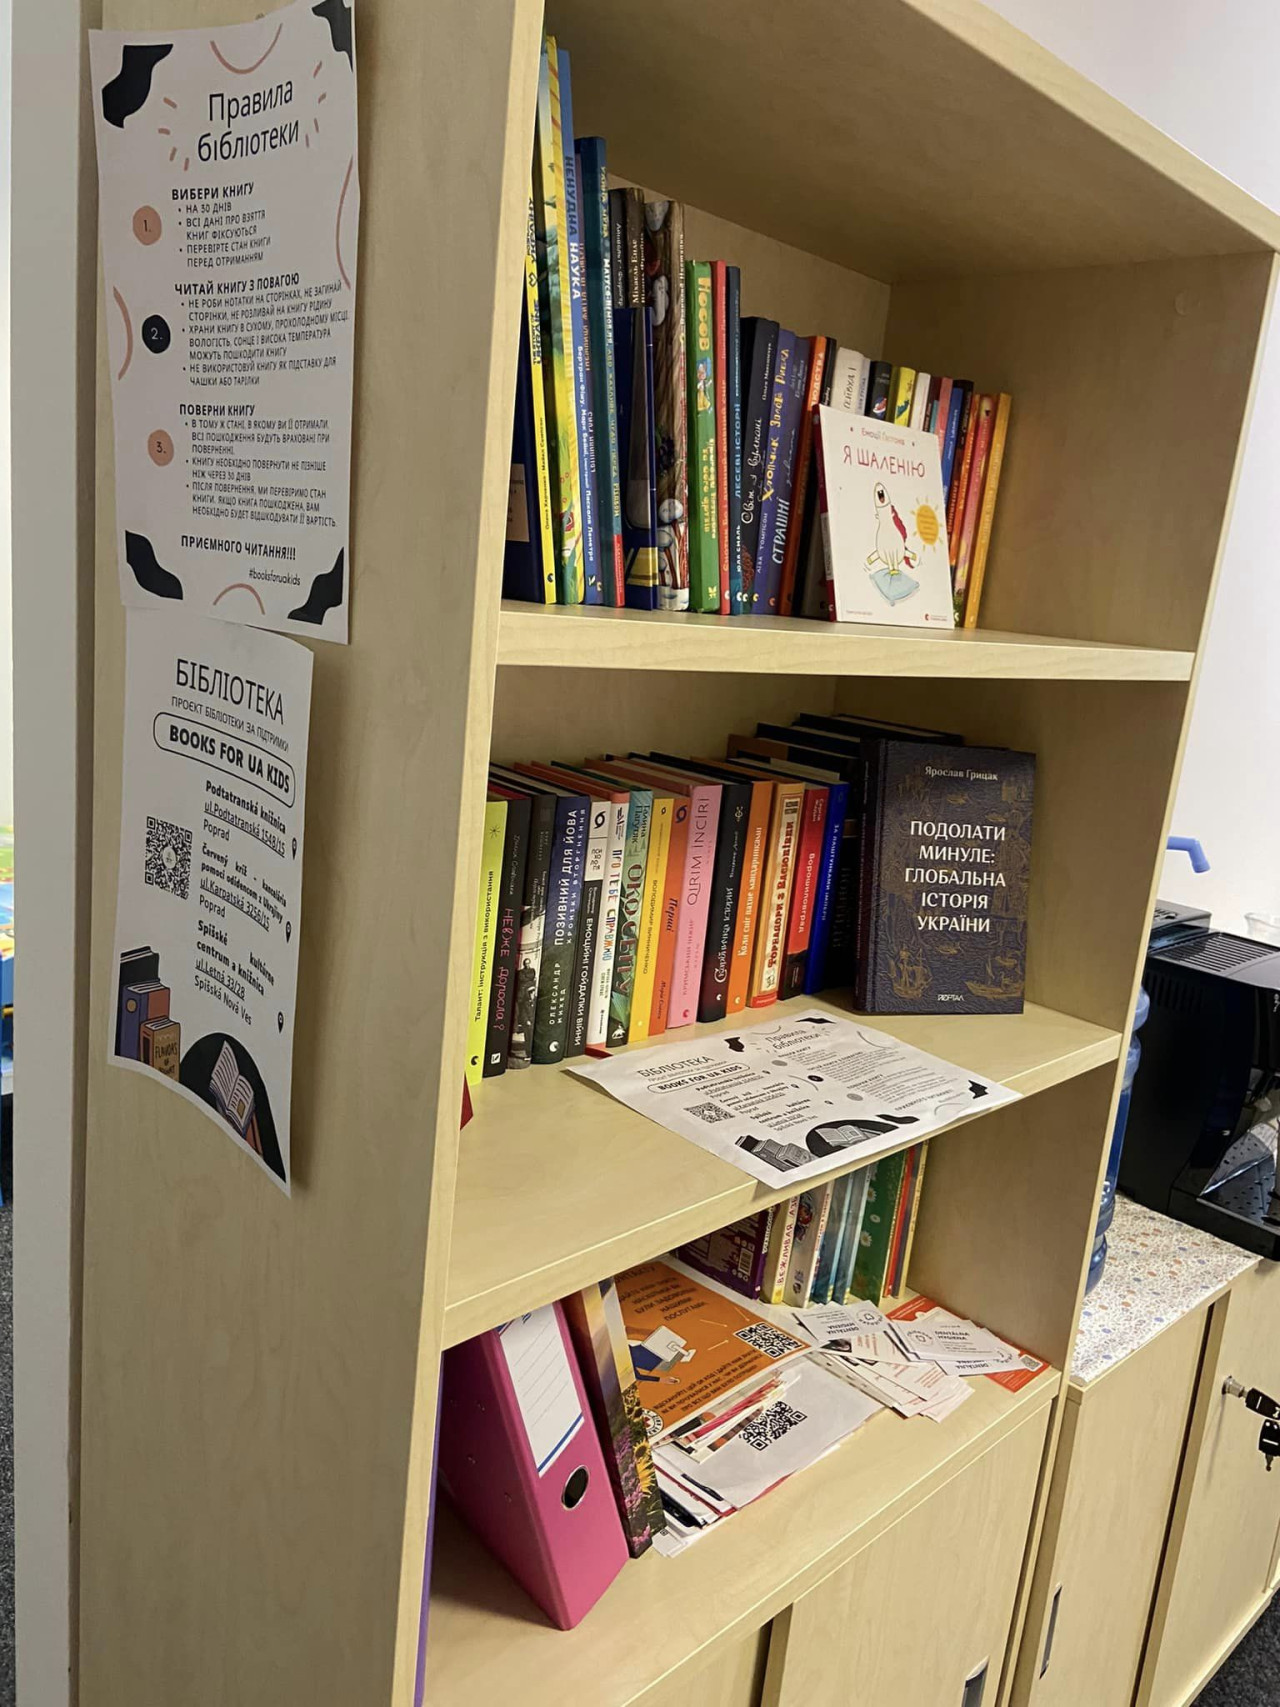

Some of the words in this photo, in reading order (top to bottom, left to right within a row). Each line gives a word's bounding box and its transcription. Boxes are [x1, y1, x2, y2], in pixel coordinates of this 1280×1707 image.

[208, 80, 293, 128] Правила
[197, 119, 299, 161] бібліотеки
[172, 187, 219, 200] ВИБЕРИ
[222, 182, 254, 198] КНИГУ
[564, 156, 578, 236] НЕНУДНА
[186, 204, 198, 214] НА
[212, 202, 232, 214] ДНІВ
[186, 218, 200, 227] ВСІ
[204, 216, 222, 228] ДАНІ
[226, 214, 240, 224] ПРО
[242, 210, 266, 222] ВЗЯТТЯ
[187, 231, 208, 240] КНИГ
[212, 225, 257, 239] ФІКСУЮТЬСЯ
[187, 243, 228, 254] ПЕРЕВІРТЕ
[231, 241, 248, 251] СТАН
[250, 236, 270, 248] КНИГИ
[188, 257, 214, 268] ПЕРЕД
[216, 252, 264, 266] ОТРИМАННЯМ
[569, 242, 582, 300] НАУКА
[174, 281, 214, 295] ЧИТАЙ
[218, 281, 247, 294] КНИГУ
[250, 280, 254, 292] З
[257, 272, 300, 290] ПОВАГОЮ
[189, 351, 222, 360] МОЖУТЬ
[224, 348, 264, 360] ПОШКОДИТИ
[266, 347, 287, 357] КНИГУ
[189, 376, 218, 386] ЧАШКИ
[220, 376, 232, 386] АБО
[234, 376, 260, 385] ТАРІЛКИ
[576, 345, 584, 381] Бертран
[580, 406, 588, 428] Марк
[180, 404, 225, 416] ПОВЕРНИ
[228, 404, 255, 416] КНИГУ
[192, 432, 204, 441] ВСІ
[206, 432, 254, 442] ПОШКОДЖЕННЯ
[257, 434, 280, 444] БУДУТЬ
[282, 434, 316, 443] ВРАХОВАНІ
[317, 434, 330, 442] ПРИ
[192, 458, 214, 468] КНИГУ
[216, 458, 250, 470] НЕОБХІДНО
[252, 459, 290, 470] ПОВЕРНУТИ
[292, 460, 300, 470] НЕ
[843, 446, 852, 465] Я
[857, 446, 926, 479] ШАЛЕНІЮ
[772, 496, 790, 564] СТРАШНІ
[181, 535, 242, 554] ПРИЄМНОГО
[245, 542, 296, 560] ЧИТАННЯ!!!
[249, 567, 300, 586] #booksforuakids
[176, 658, 284, 725] БІБЛІОТЕКА
[205, 706, 244, 730] БІБЛІОТЕКИ
[246, 722, 256, 736] ЗА
[170, 724, 216, 756] BOOKS
[220, 742, 244, 768] FOR
[248, 754, 264, 778] UA
[266, 763, 290, 794] KIDS
[924, 766, 964, 778] Ярослав
[966, 768, 998, 782] Грицак
[204, 800, 260, 838] ul.Podtatranská
[206, 780, 258, 815] Podtatranská
[260, 805, 286, 834] knižnica
[204, 818, 230, 841] Poprad
[566, 810, 578, 842] ЙОВА
[834, 824, 840, 834] ЗА
[910, 820, 1006, 841] ПОДОЛАТИ
[202, 842, 228, 868] Červený
[562, 843, 574, 874] ДЛЯ
[748, 826, 762, 890] мандаринками
[827, 836, 839, 891] ЛАШТУНКАМИ
[919, 844, 996, 864] МИНУЛЕ:
[201, 862, 225, 880] pomoci
[226, 875, 258, 900] odídencom
[262, 900, 283, 924] Ukrajiny
[566, 895, 577, 945] ХРОНІКИ
[573, 809, 586, 889] ВТОРГНЕННЯ
[608, 871, 621, 904] ТЕБЕ
[687, 854, 702, 906] QIRIM
[798, 852, 816, 934] Ворошиловград
[904, 868, 1006, 888] ГЛОБАЛЬНА
[199, 894, 226, 918] Poprad
[200, 877, 245, 910] ul.Karpatská
[484, 870, 495, 932] використання
[746, 890, 755, 915] пахне
[920, 892, 988, 910] ІСТОРІЯ
[554, 878, 572, 946] ПОЗИВНИЙ
[665, 897, 678, 933] Перші
[917, 913, 990, 933] УКРАЇНИ
[500, 908, 514, 958] НЕВЖЕ
[585, 918, 594, 968] ЕМОЦІЙНІ
[738, 932, 749, 957] Коли
[196, 941, 230, 967] centrum
[232, 961, 236, 972] a
[238, 963, 264, 996] knižnica
[198, 920, 228, 946] Spišské
[250, 952, 274, 986] kultúrne
[478, 940, 488, 986] інструкція
[643, 930, 652, 976] ВИННИЧЕНКО
[195, 958, 225, 981] ul.Letná
[194, 975, 222, 1000] Spišská
[224, 992, 240, 1014] Nová
[240, 1006, 252, 1026] Ves
[474, 988, 484, 1022] Талант:
[550, 961, 560, 1025] ОЛЕКСАНДР
[578, 969, 589, 1017] ГОЙДАЛКИ
[574, 1018, 583, 1046] ВІЙНИ
[636, 1056, 715, 1078] БІБЛІОТЕКА
[658, 1080, 689, 1090] BOOKS
[720, 1065, 743, 1074] KIDS
